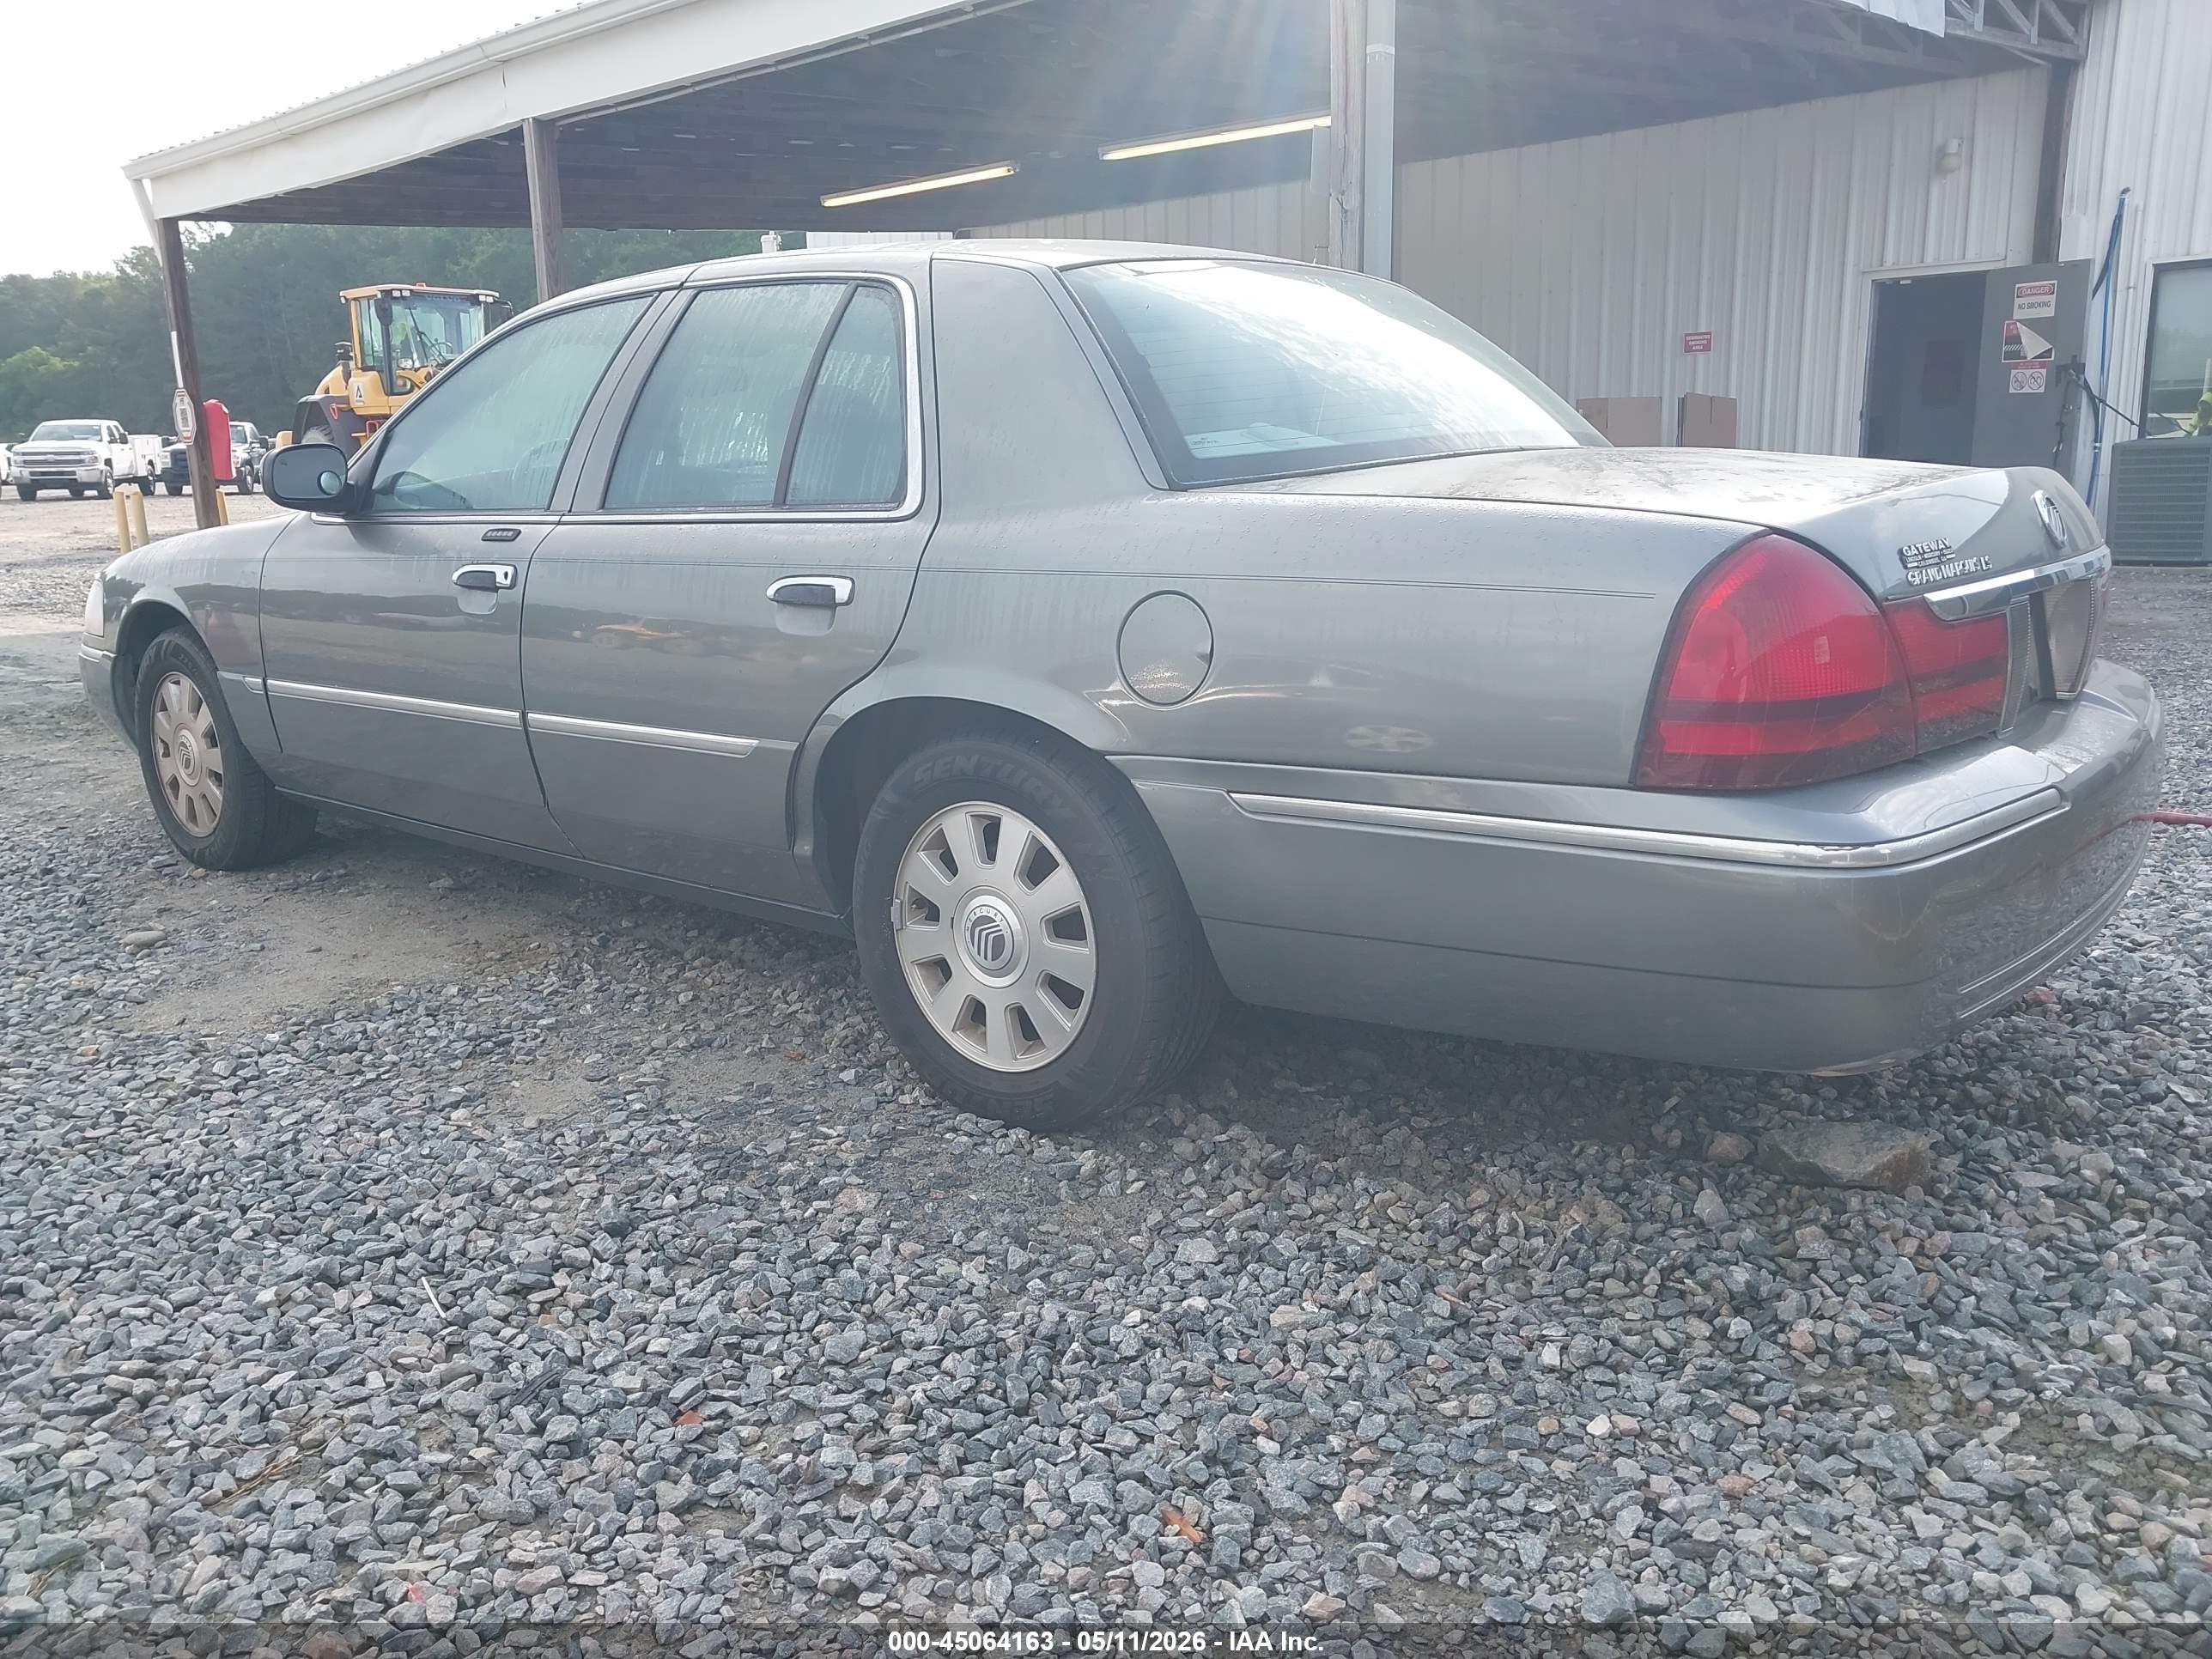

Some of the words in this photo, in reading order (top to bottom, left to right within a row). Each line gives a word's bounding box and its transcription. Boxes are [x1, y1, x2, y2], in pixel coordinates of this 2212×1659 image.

[2021, 286, 2050, 295] DANGER
[2027, 301, 2051, 309] SMOKING
[1902, 538, 1951, 556] GATEWAY
[1907, 567, 1942, 585] GRAND
[1980, 556, 1993, 571] LS
